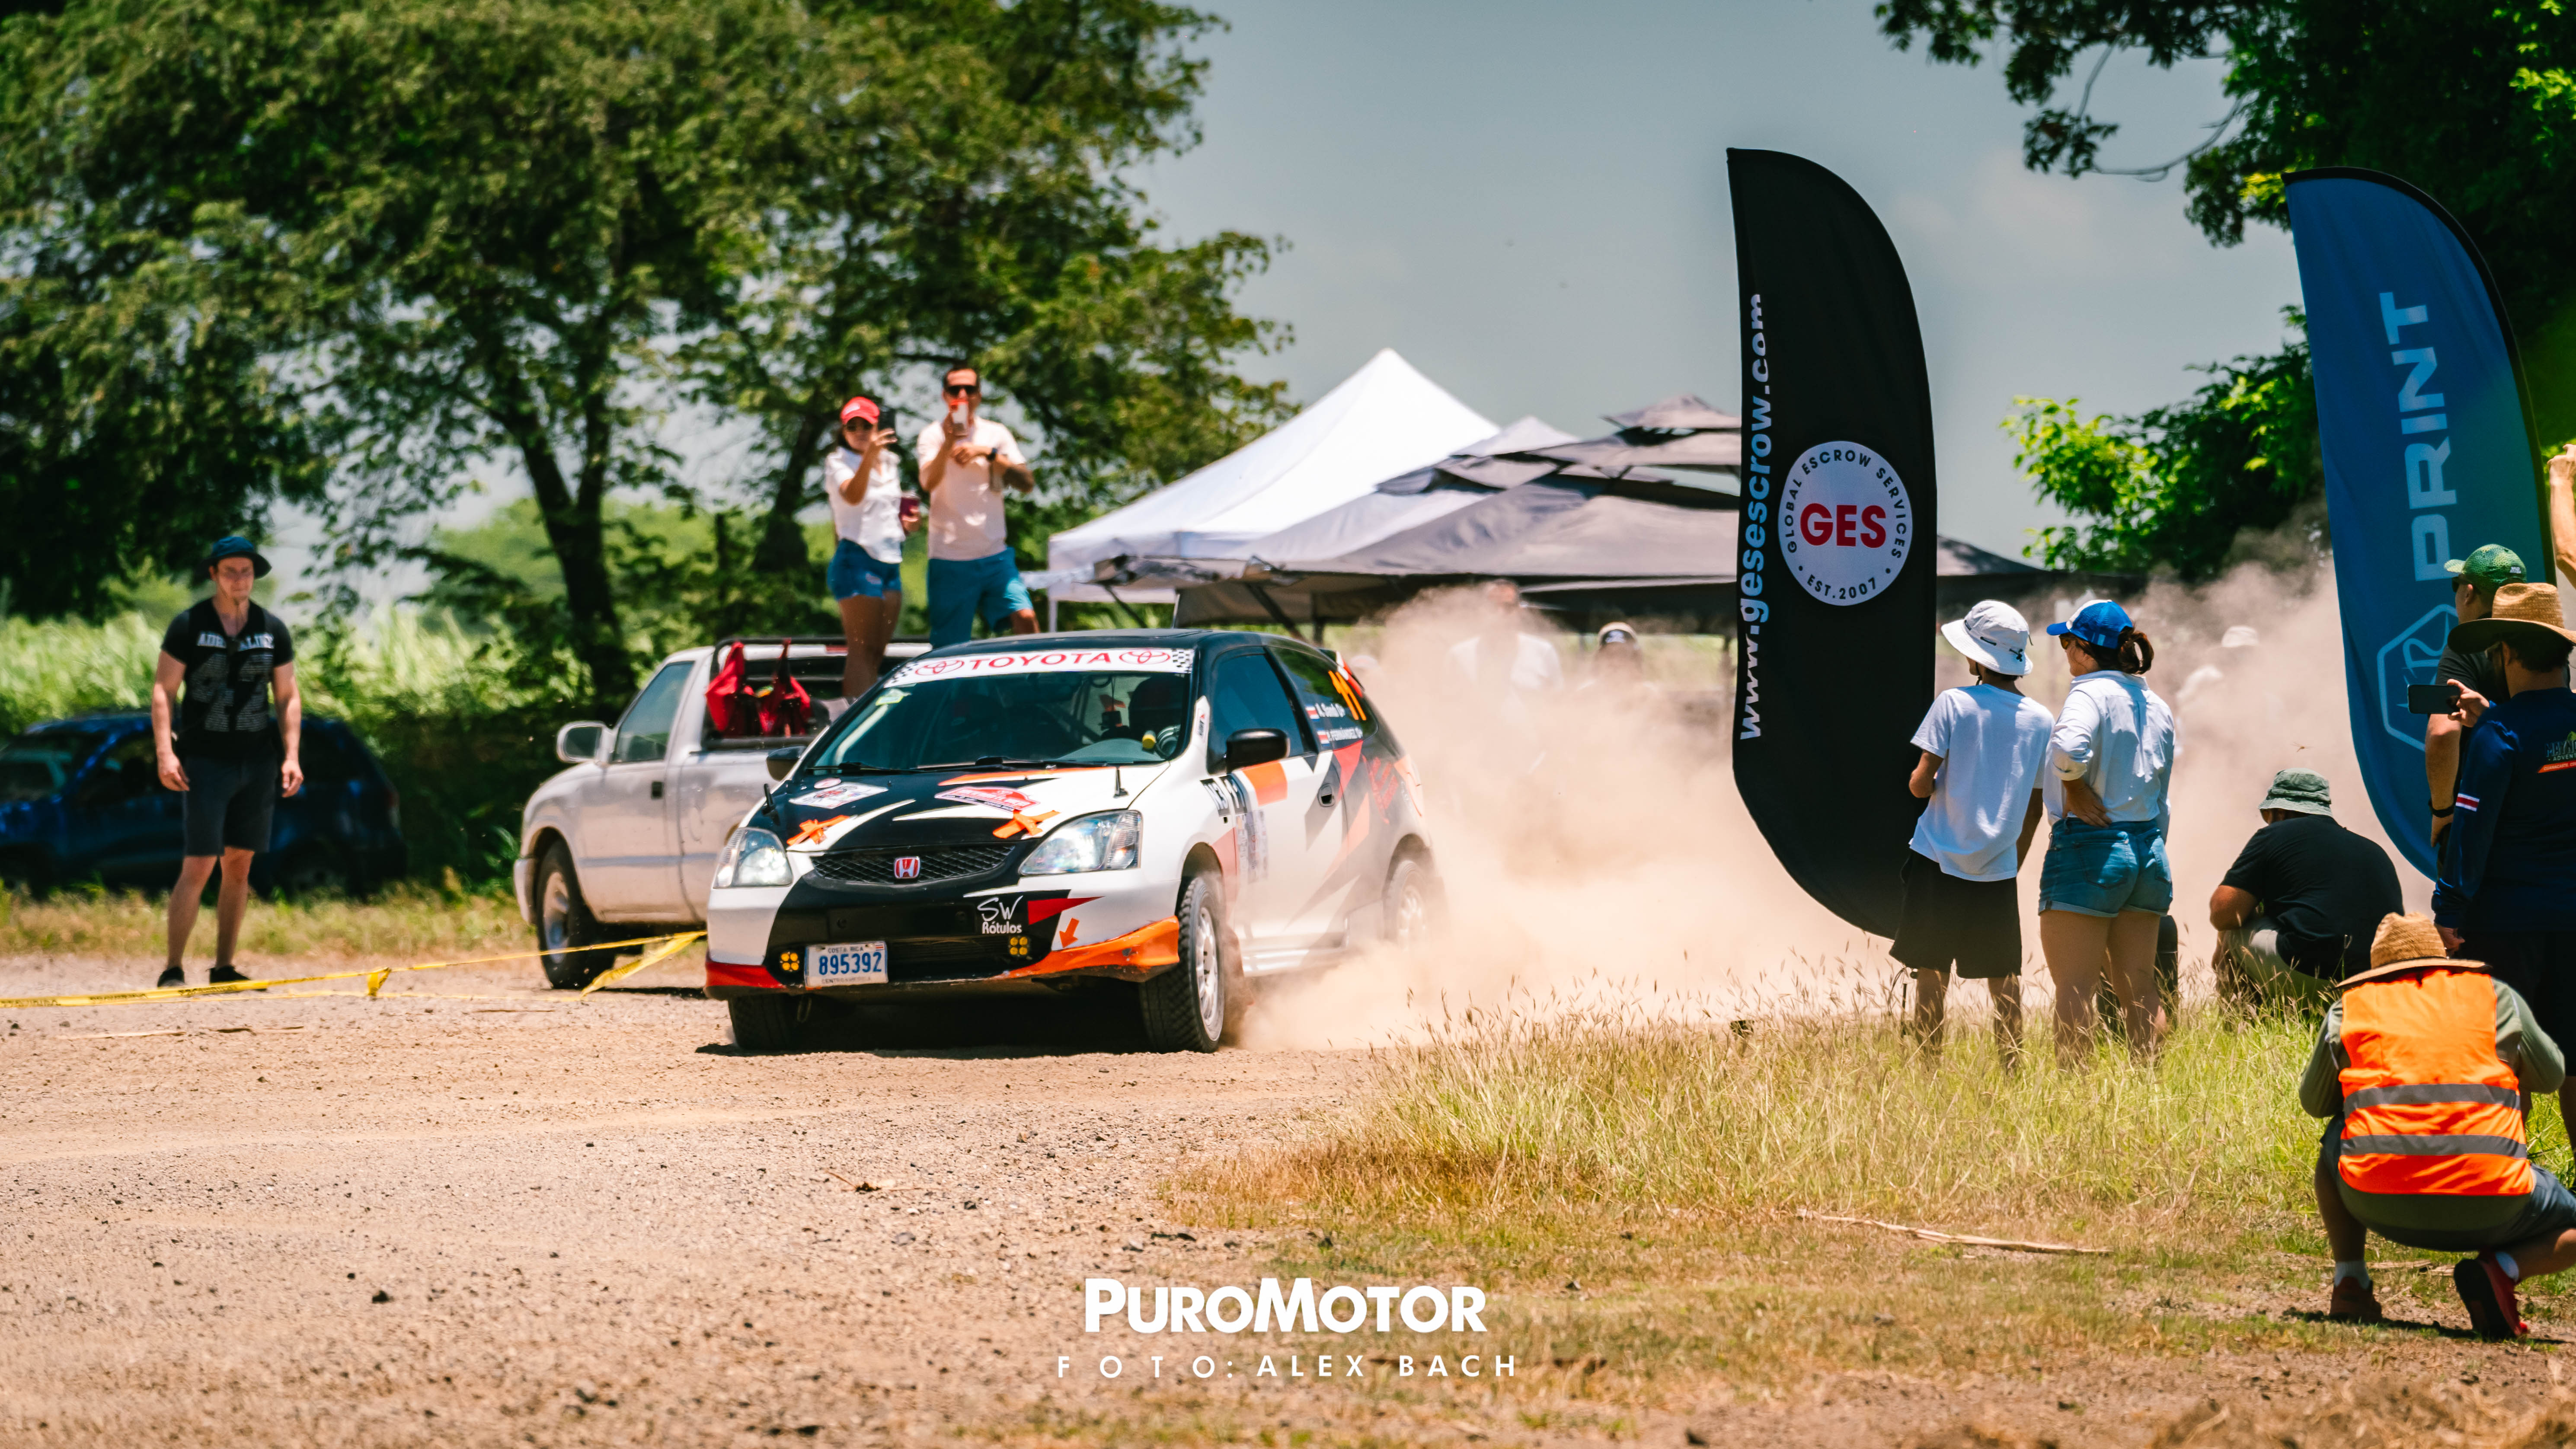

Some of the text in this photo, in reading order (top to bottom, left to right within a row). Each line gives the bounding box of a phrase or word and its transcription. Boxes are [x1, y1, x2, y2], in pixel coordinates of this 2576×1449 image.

[2379, 292, 2459, 581] PRINT
[1740, 294, 1771, 740] www.gesescrow.com
[1785, 449, 1907, 559] GLOBAL ESCROW SERVICES
[1800, 503, 1886, 548] GES
[969, 652, 1112, 670] TOYOTA
[977, 896, 1023, 922] SW
[982, 921, 1022, 934] Rótulos
[819, 952, 882, 975] 895392
